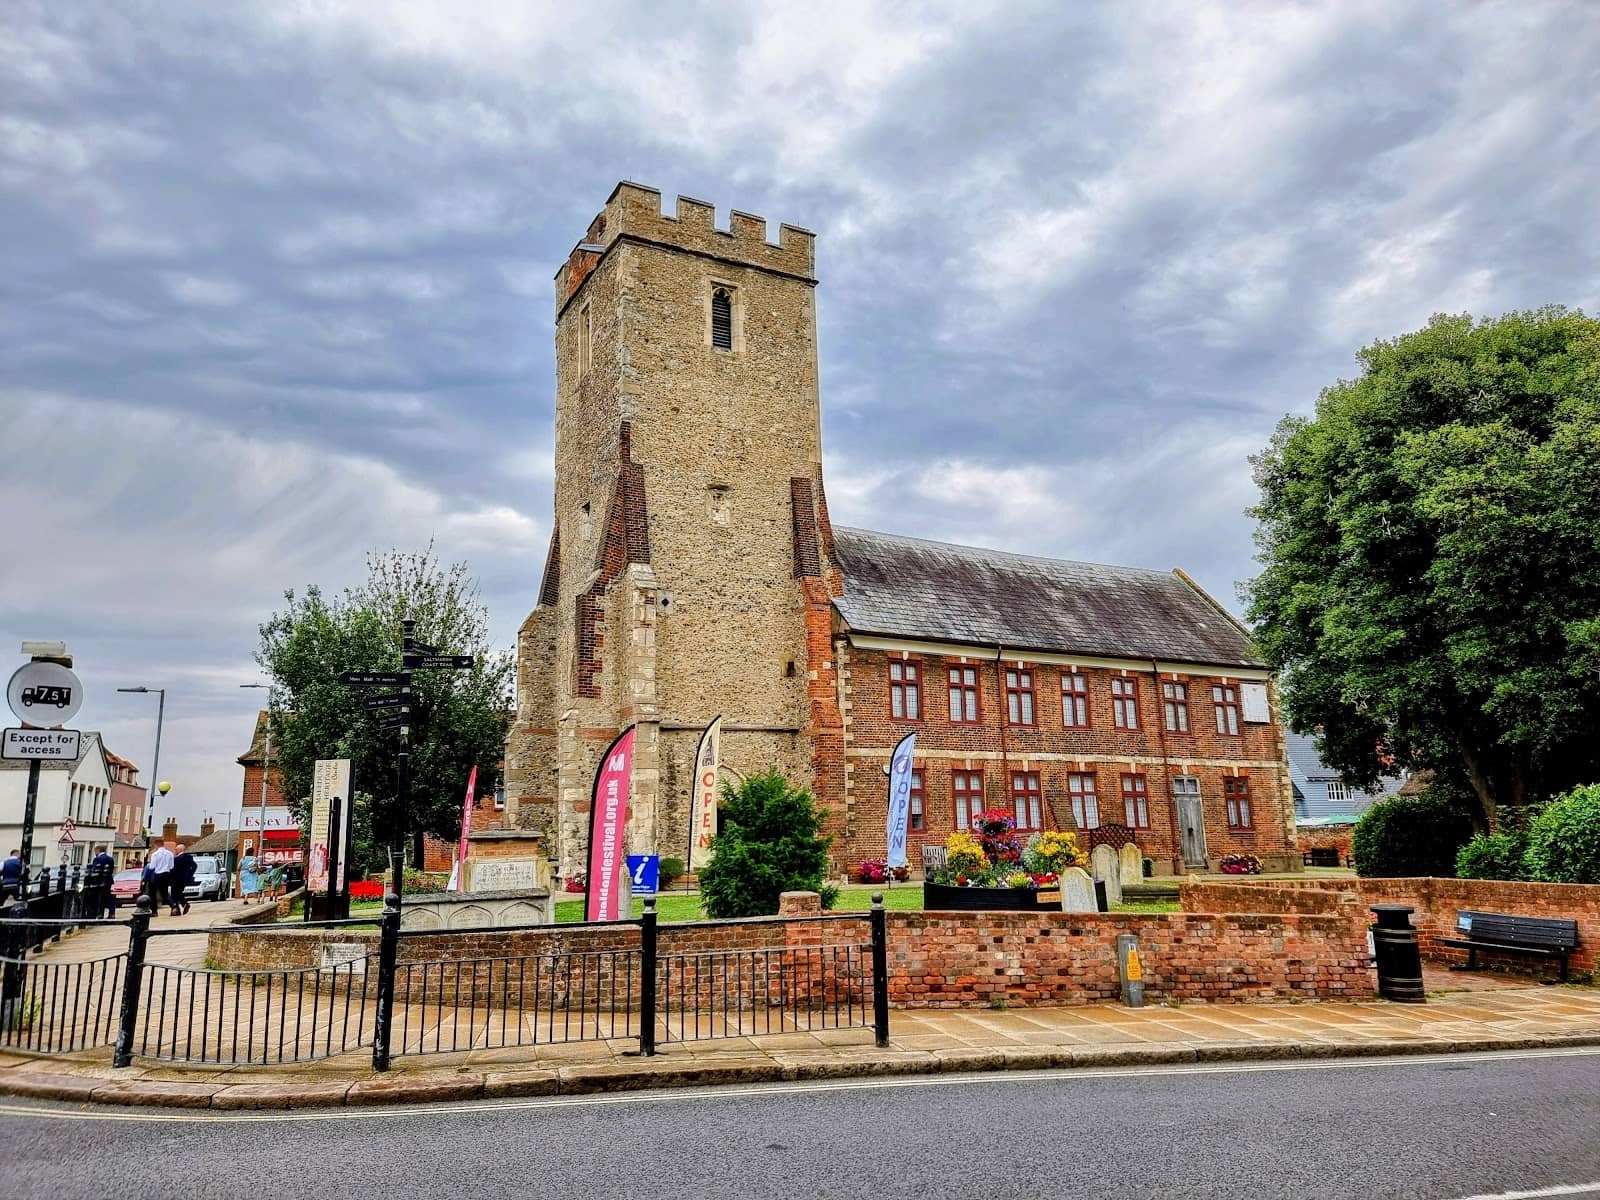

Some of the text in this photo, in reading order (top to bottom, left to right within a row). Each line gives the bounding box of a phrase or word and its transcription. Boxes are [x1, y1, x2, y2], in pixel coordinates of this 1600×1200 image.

[38, 688, 69, 701] 7.5 T
[10, 733, 75, 744] Except for
[21, 746, 62, 755] access
[323, 762, 332, 800] HERITAGE
[699, 772, 715, 848] OPEN
[892, 783, 908, 849] OPEN
[245, 816, 281, 827] Esex
[264, 851, 303, 862] SALE
[598, 779, 619, 921] maldonfestival.org.uk
